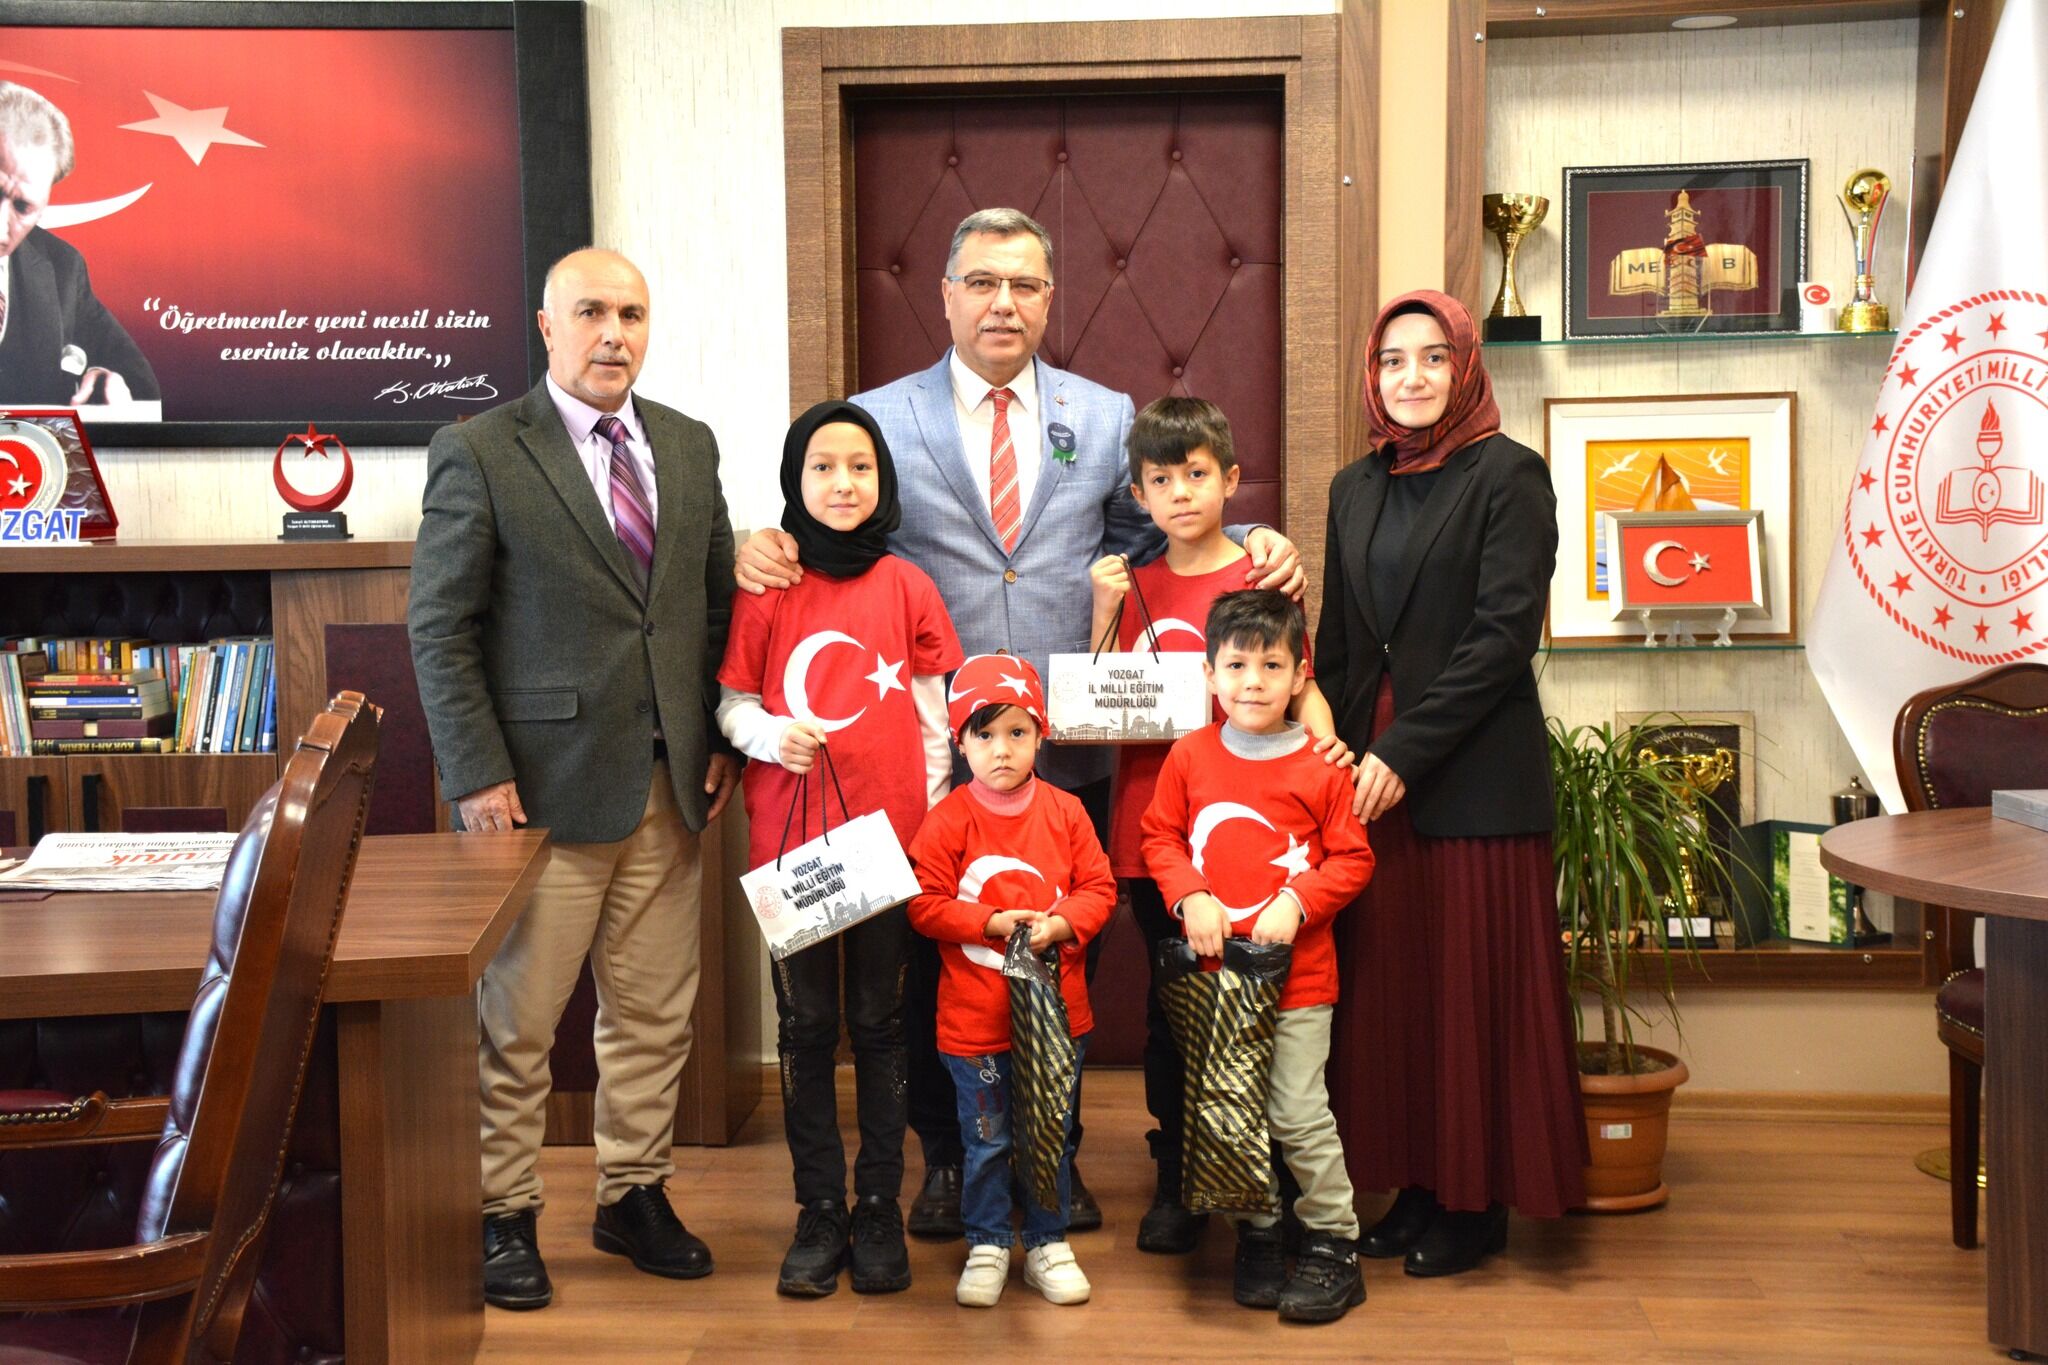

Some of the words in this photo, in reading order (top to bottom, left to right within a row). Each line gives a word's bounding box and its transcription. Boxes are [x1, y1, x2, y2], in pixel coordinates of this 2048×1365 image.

[1722, 257, 1736, 270] B
[314, 309, 367, 333] yeni
[373, 309, 429, 329] nesil
[435, 309, 492, 329] sizin
[220, 341, 310, 361] eseriniz
[1895, 359, 1983, 504] CUMHURİYETİ
[0, 510, 86, 540] ZGAT
[1900, 511, 1968, 591] TÜRKİYE
[1108, 669, 1145, 680] YOZGAT
[1088, 682, 1097, 694] İL
[1100, 682, 1127, 694] MİLLİ
[1130, 681, 1164, 694] EĞİTİM
[1094, 695, 1157, 708] MÜDÜRLÜĞÜ
[792, 857, 823, 878] YOZGAT
[781, 879, 794, 900] İL
[792, 876, 818, 896] MİLLİ
[816, 863, 845, 883] EĞİTİM
[793, 877, 847, 912] MÜDÜRLÜĞÜ
